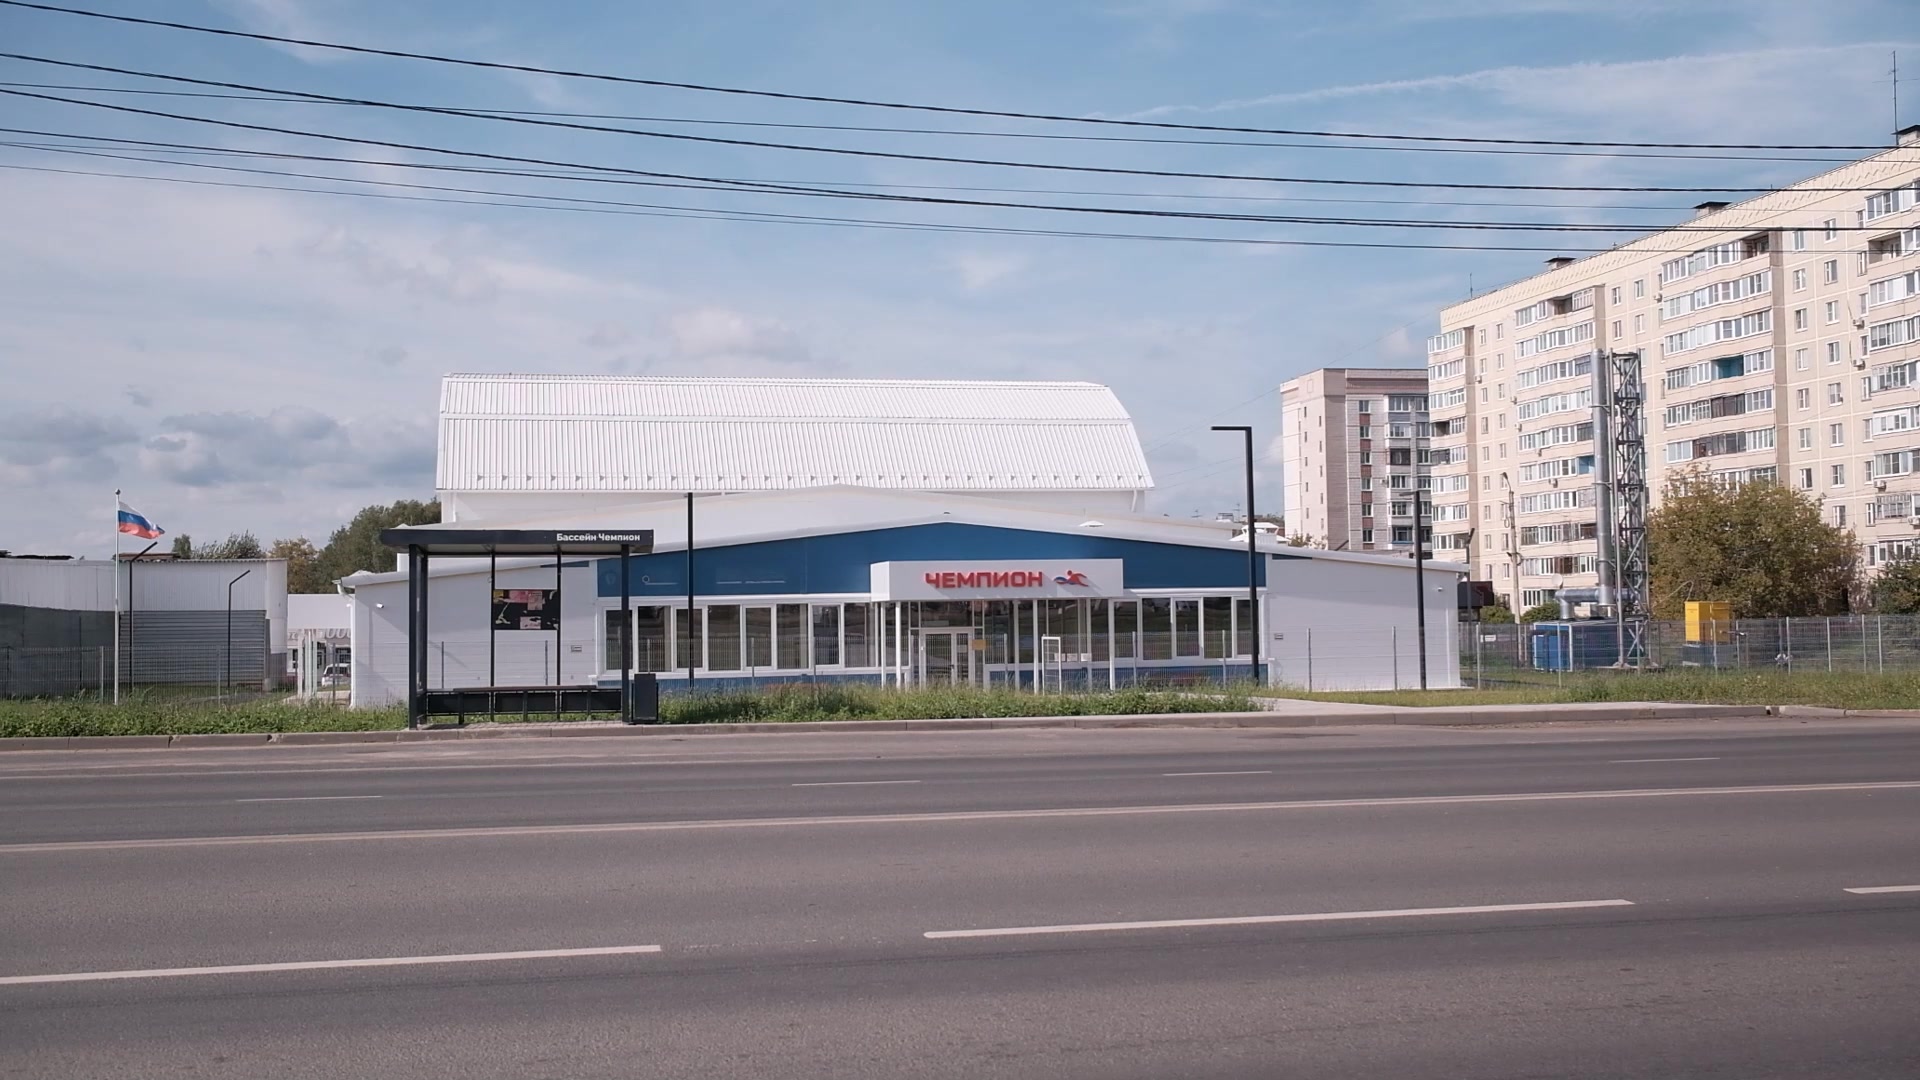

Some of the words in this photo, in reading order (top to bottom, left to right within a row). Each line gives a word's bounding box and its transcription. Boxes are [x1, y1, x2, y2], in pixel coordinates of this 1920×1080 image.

[556, 533, 597, 541] Бассейн
[598, 533, 640, 541] Чемпион
[925, 571, 1043, 588] ЧЕМПИОН
